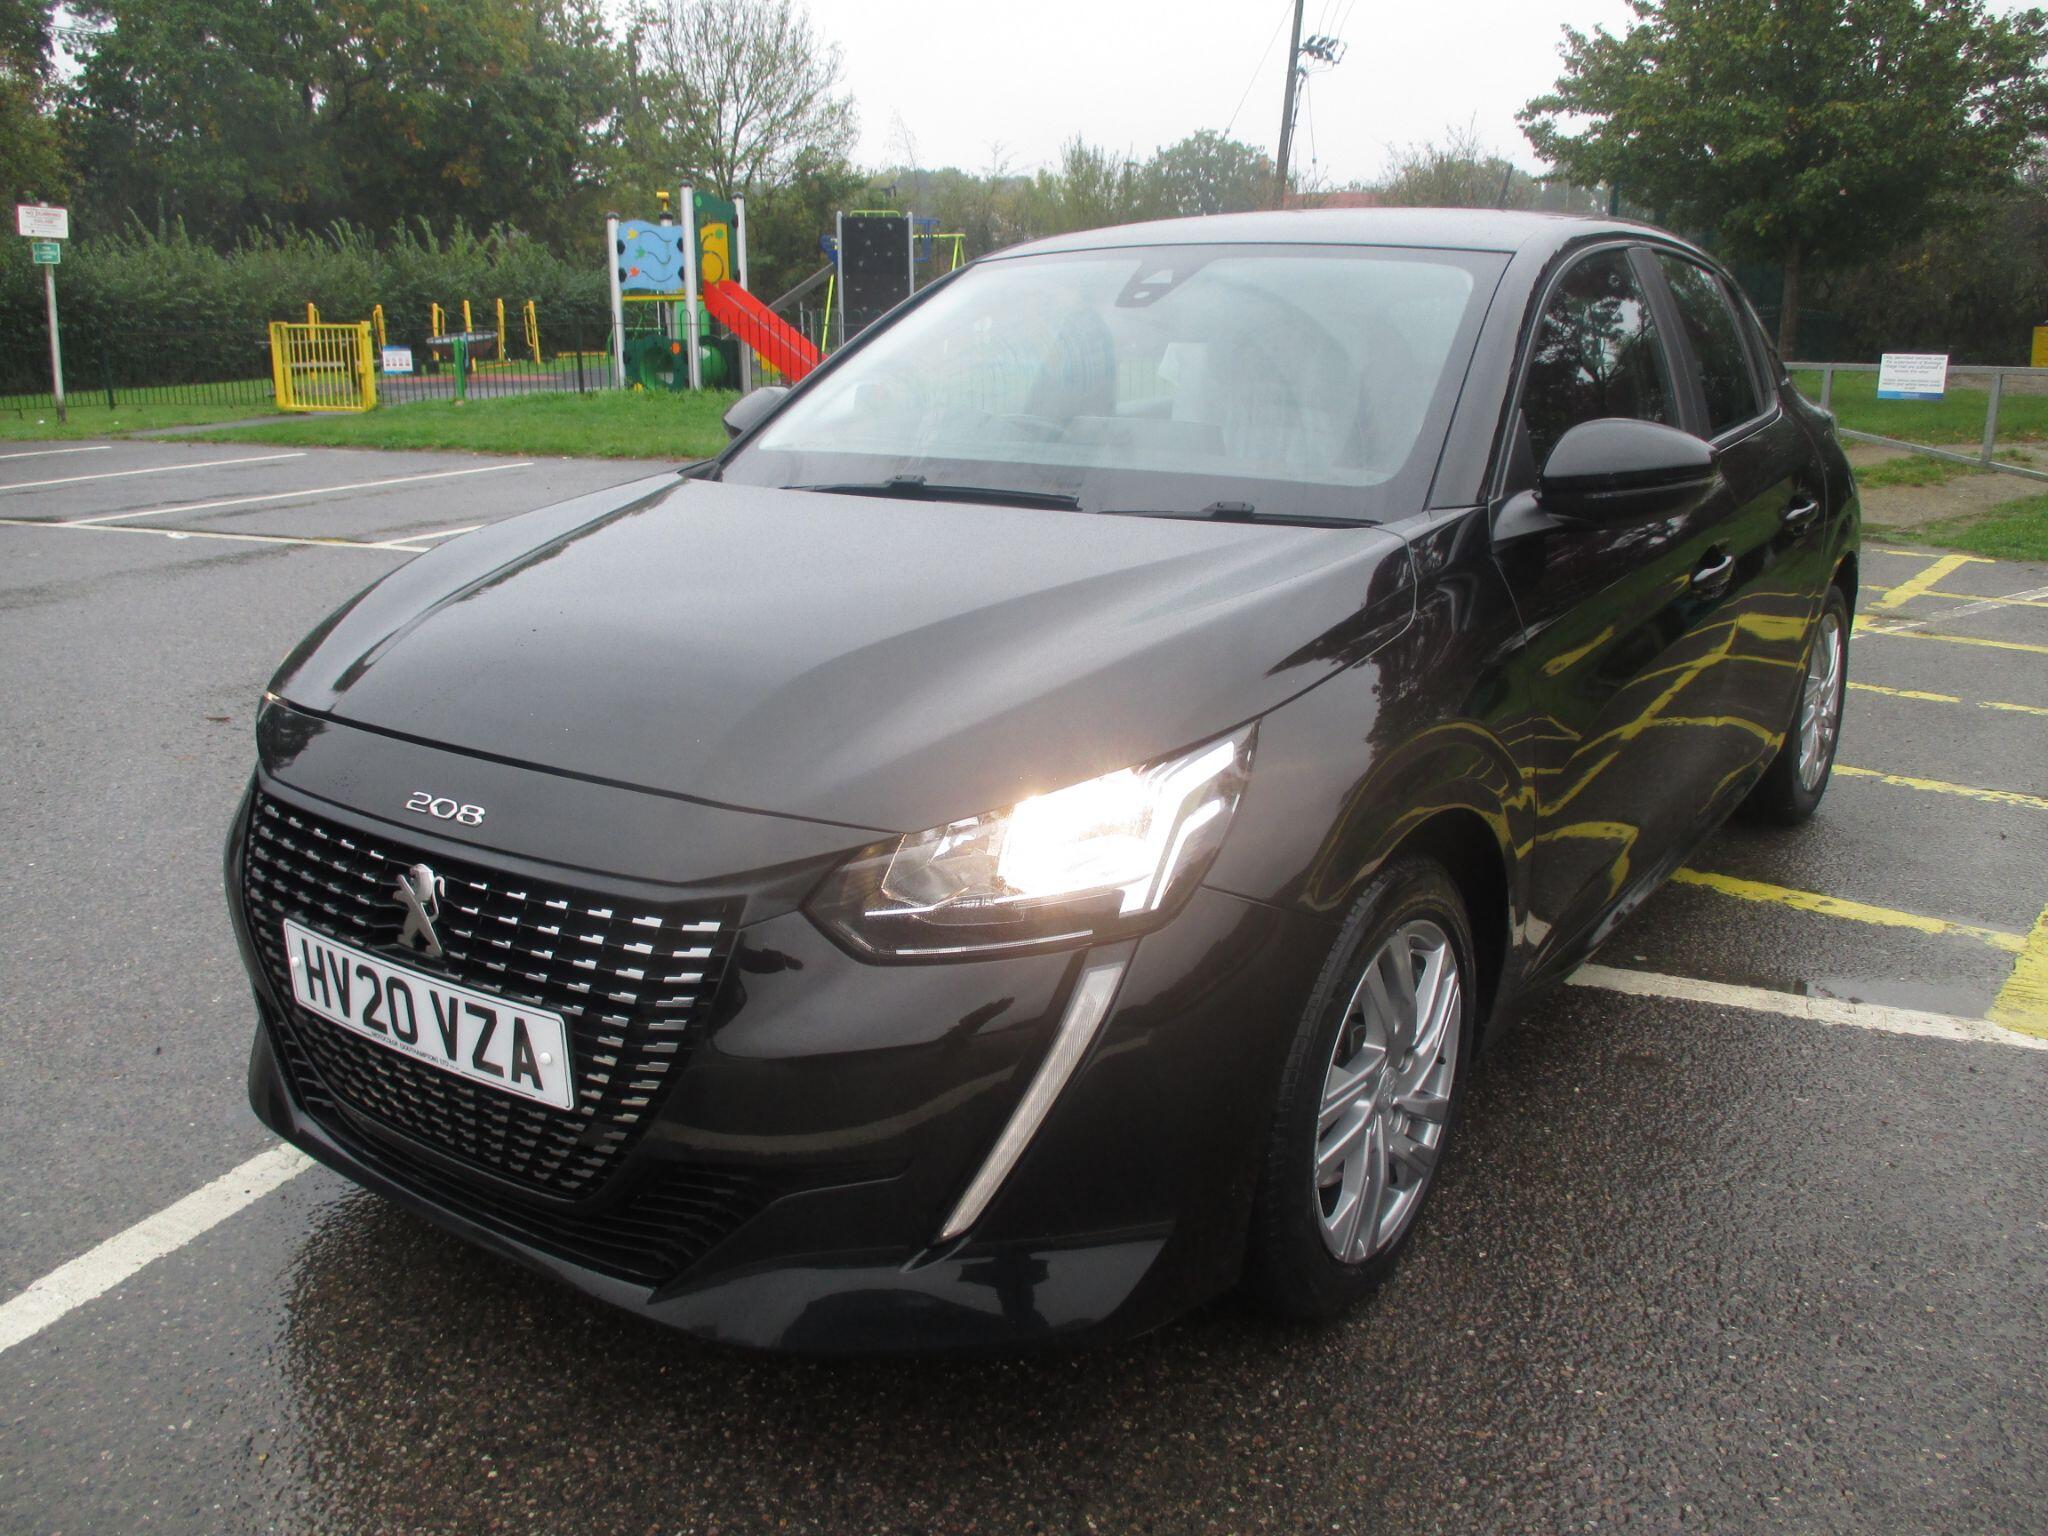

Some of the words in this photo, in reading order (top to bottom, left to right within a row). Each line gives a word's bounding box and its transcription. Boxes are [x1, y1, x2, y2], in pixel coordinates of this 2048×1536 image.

[405, 791, 486, 827] 208
[301, 938, 419, 1046] HV20
[429, 989, 544, 1091] VZA
